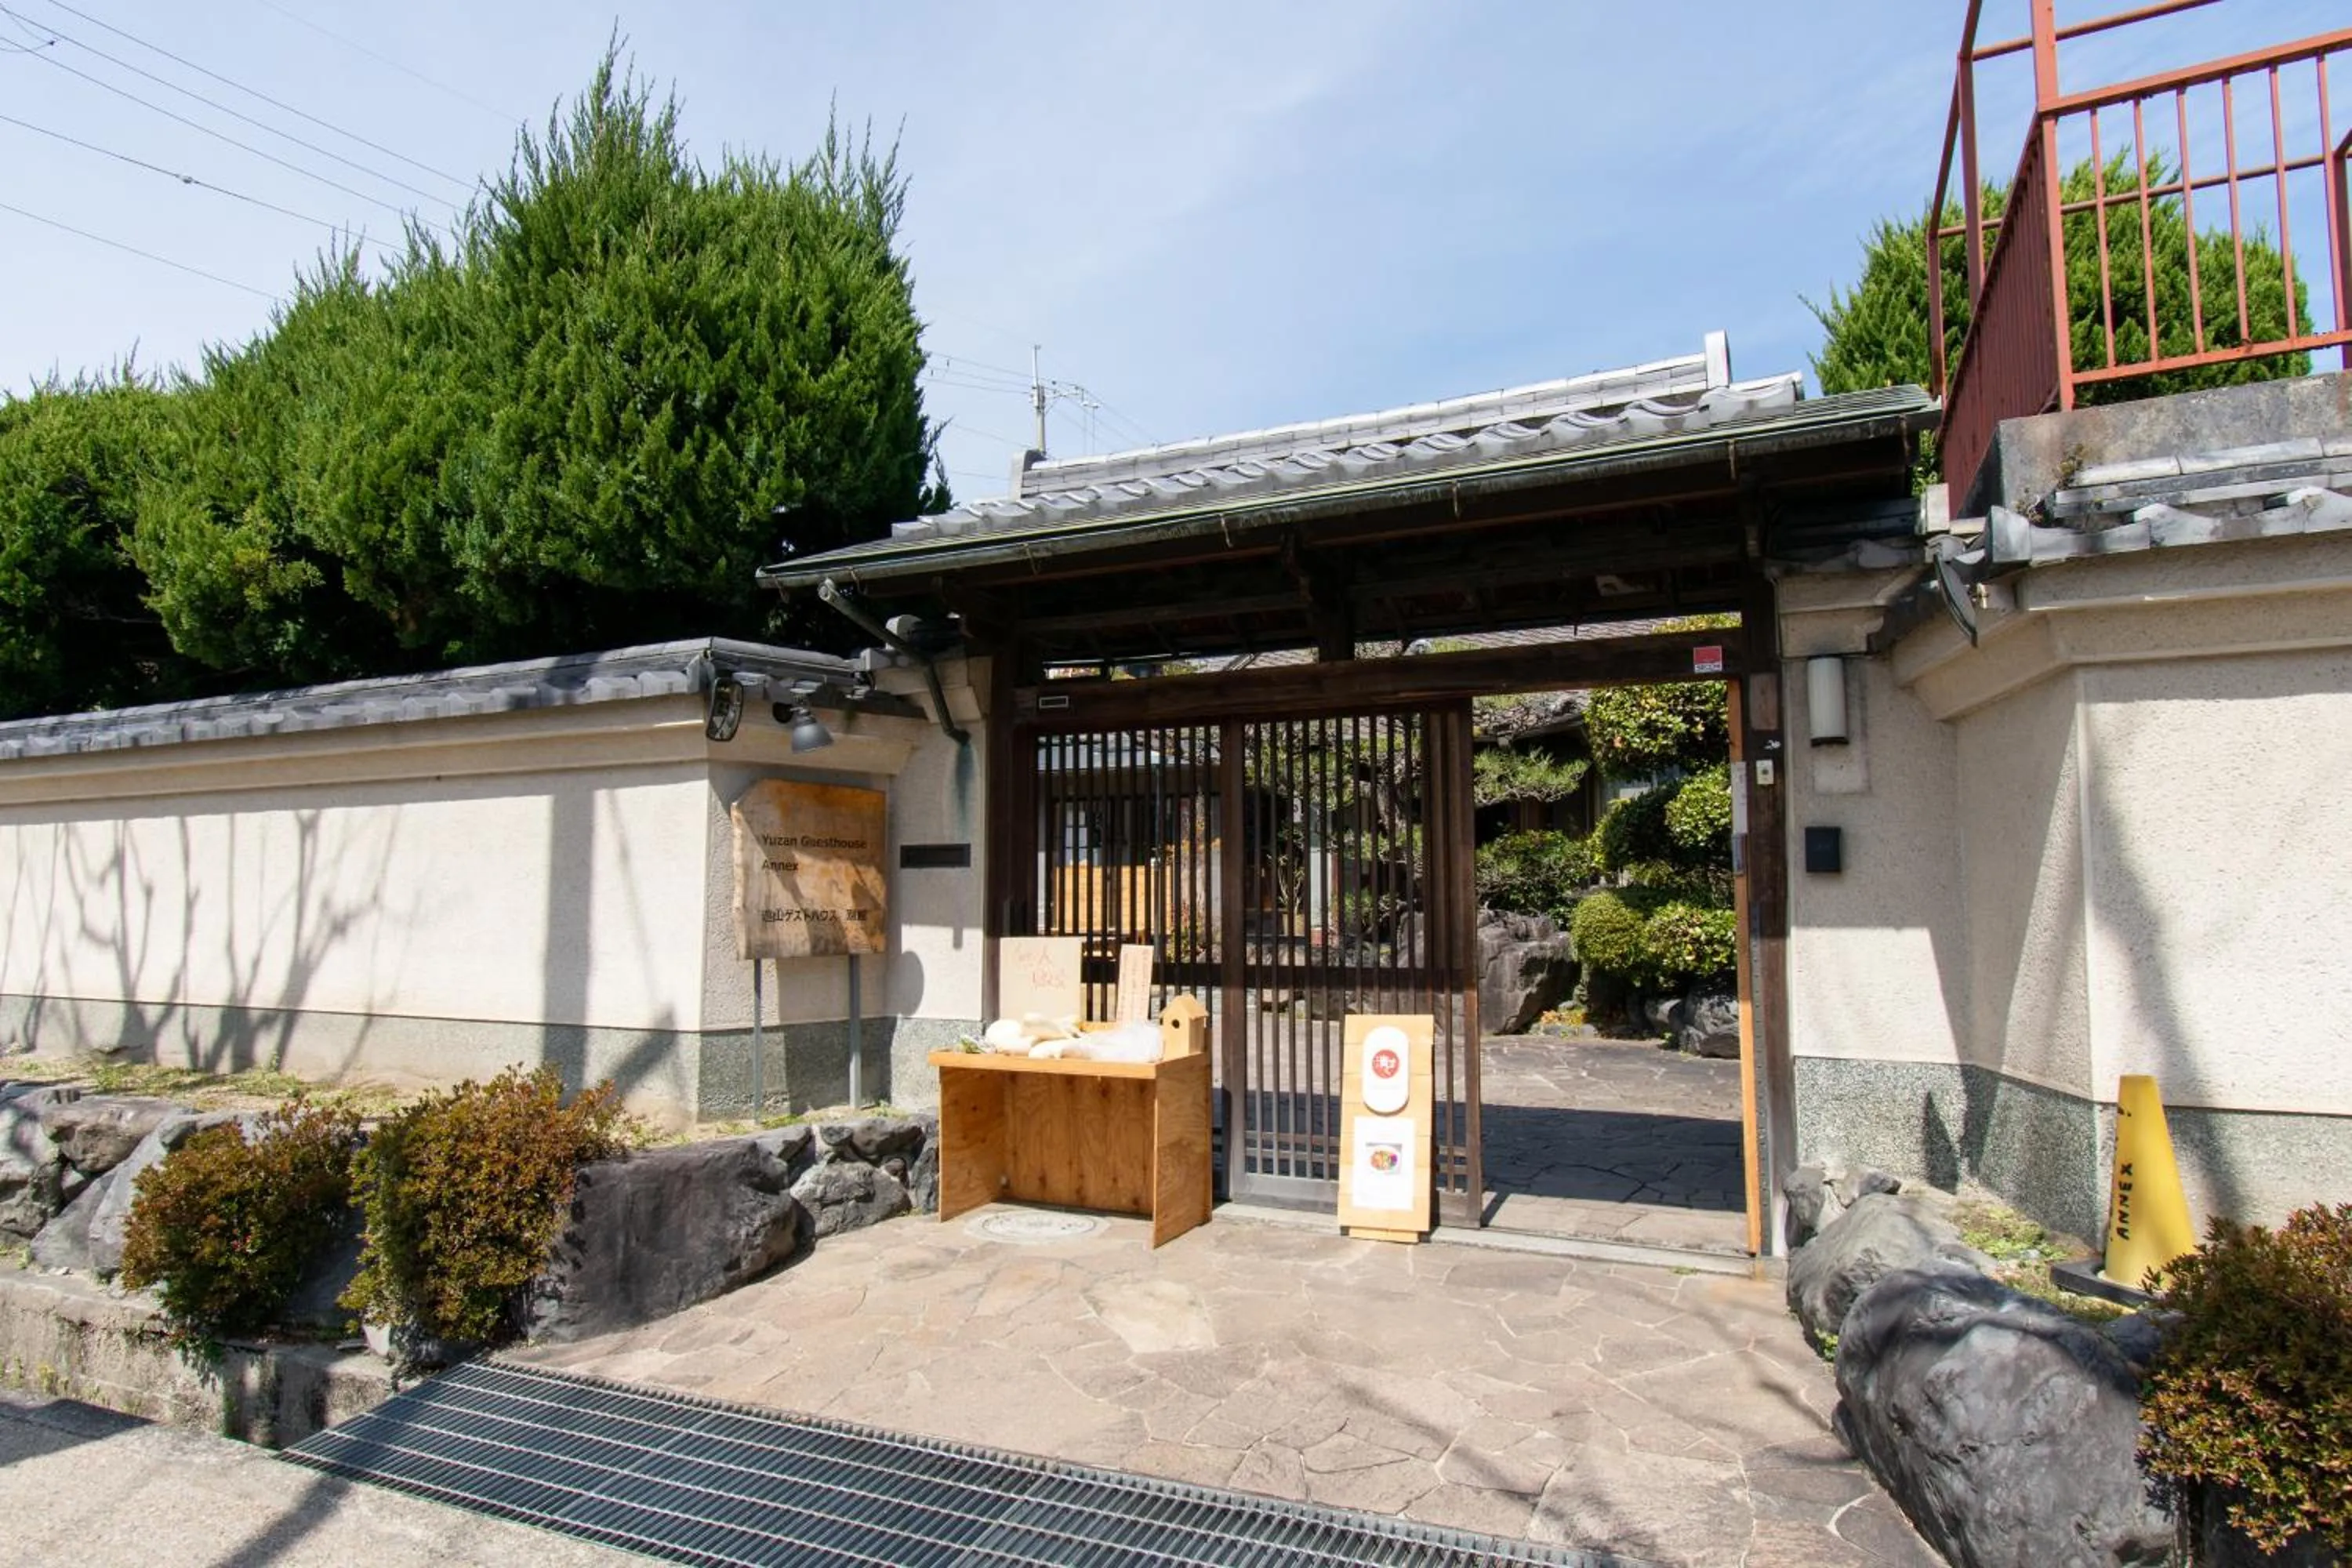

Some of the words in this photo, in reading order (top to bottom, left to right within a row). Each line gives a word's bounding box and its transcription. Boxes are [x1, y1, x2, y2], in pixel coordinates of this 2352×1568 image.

[762, 834, 797, 847] Yuzan
[800, 836, 867, 849] Guesthouse
[762, 859, 799, 871] Annex
[2116, 1163, 2133, 1241] ANNEX
